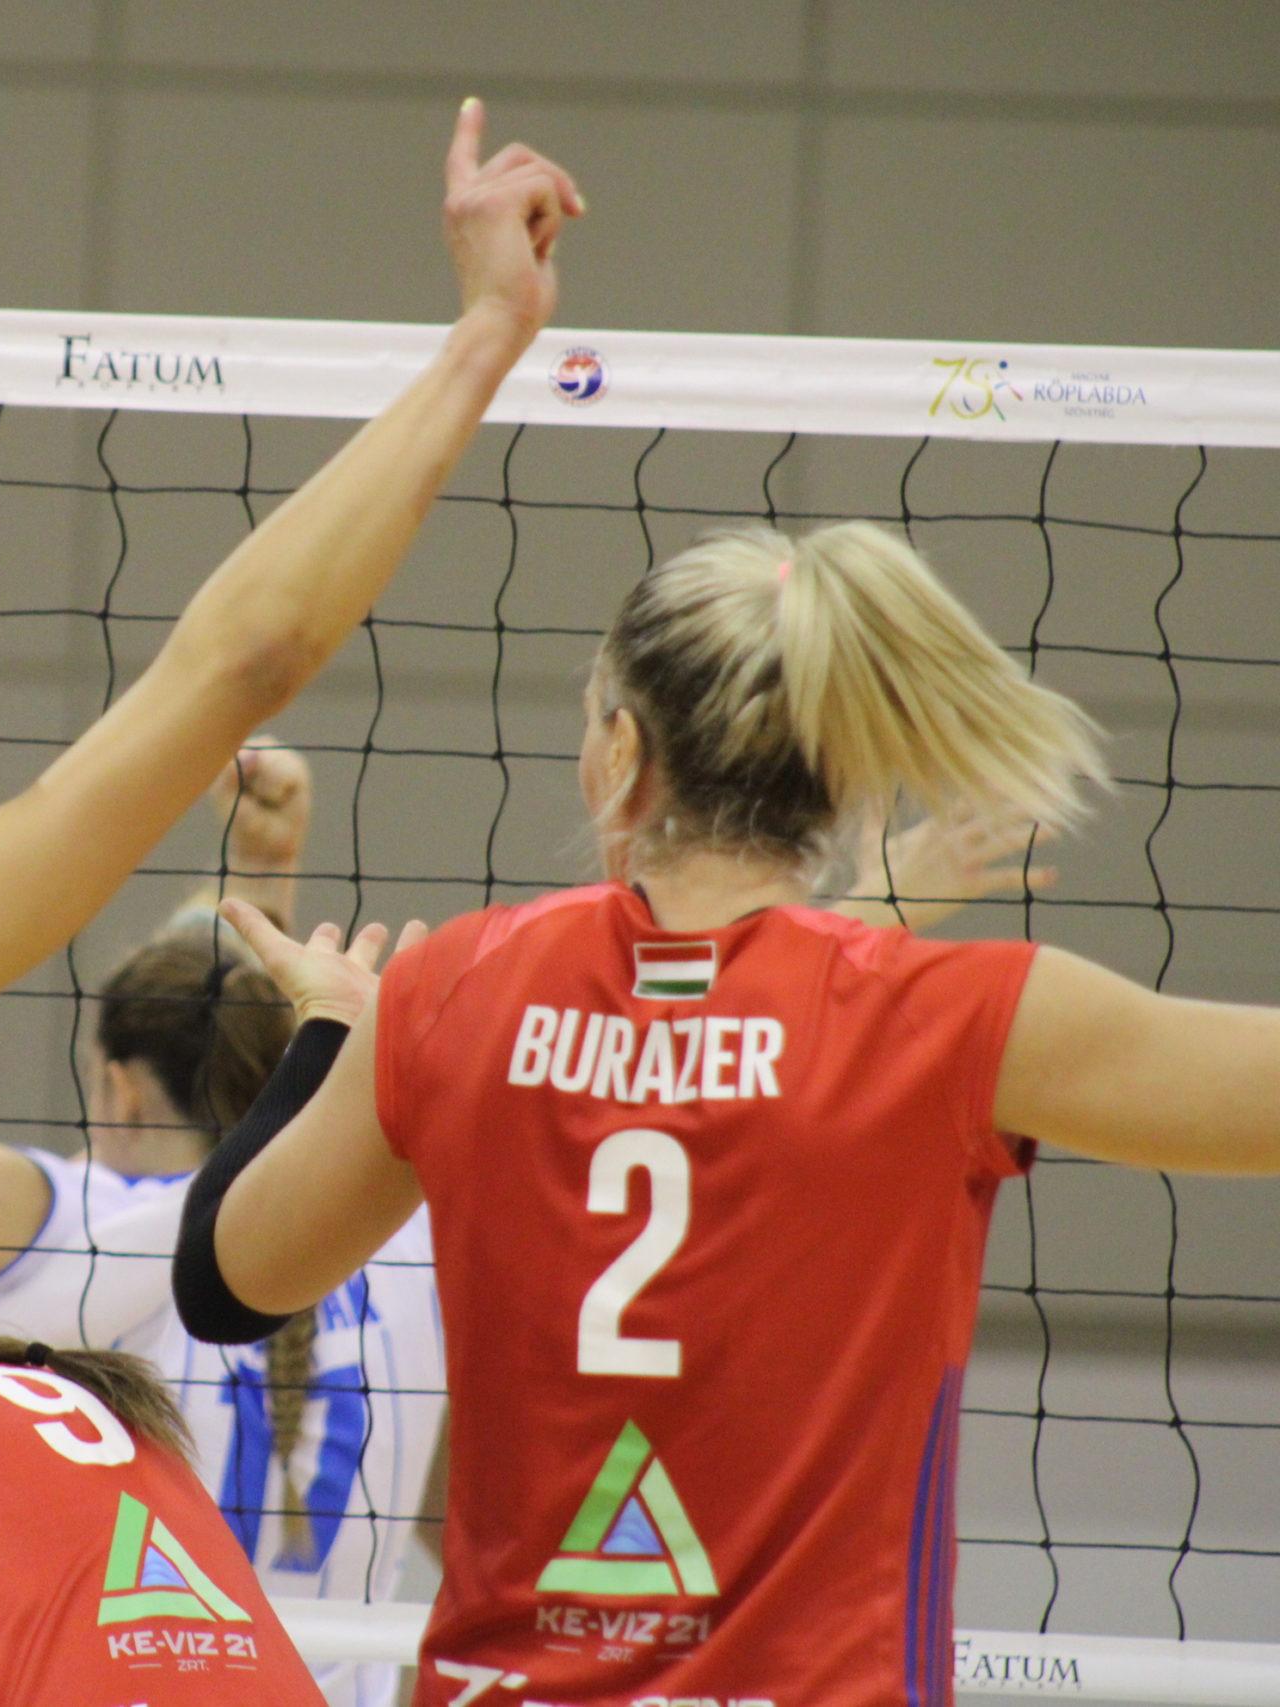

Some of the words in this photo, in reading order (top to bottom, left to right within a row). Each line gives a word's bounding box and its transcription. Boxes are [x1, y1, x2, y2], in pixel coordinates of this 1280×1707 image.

[60, 333, 224, 386] FATUM
[508, 1004, 785, 1105] BURAZER
[577, 1128, 691, 1377] 2
[107, 1630, 220, 1660] KE-VIZ
[223, 1632, 258, 1660] 21
[535, 1605, 664, 1643] KE-VIZ
[665, 1613, 711, 1643] 21
